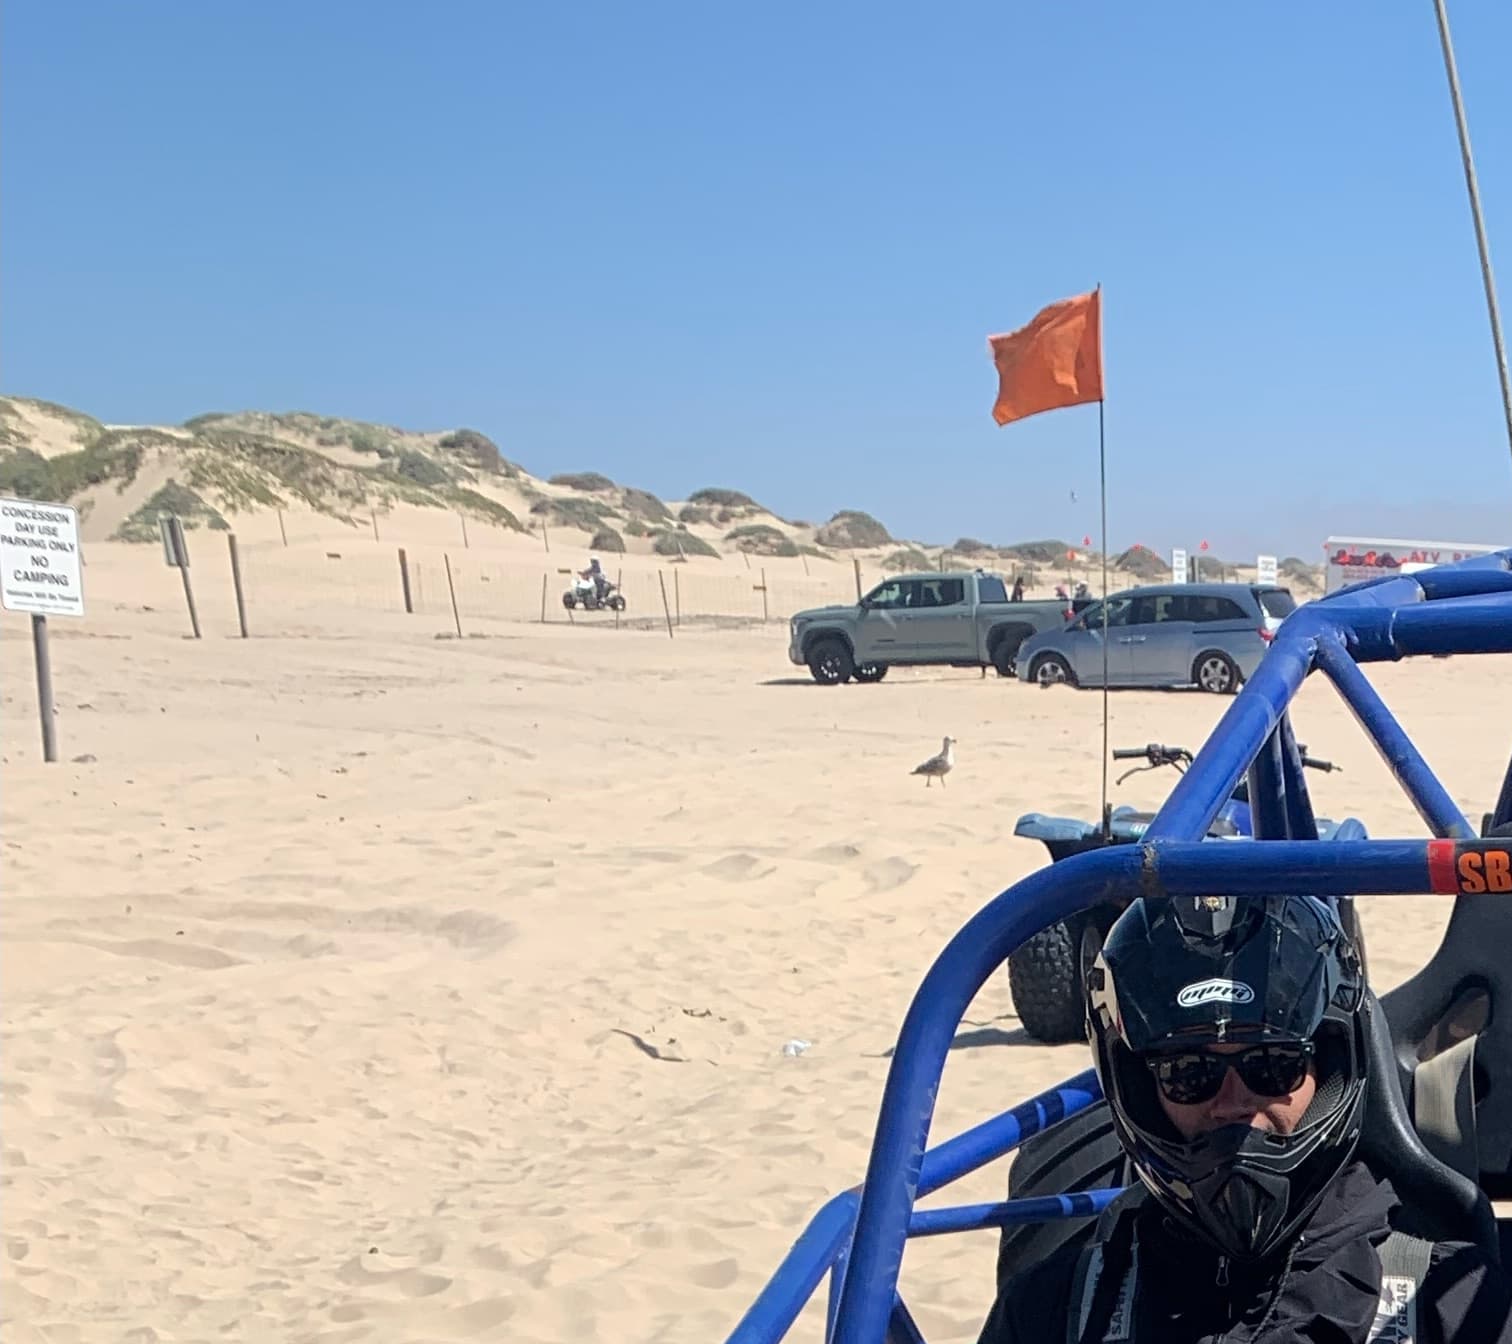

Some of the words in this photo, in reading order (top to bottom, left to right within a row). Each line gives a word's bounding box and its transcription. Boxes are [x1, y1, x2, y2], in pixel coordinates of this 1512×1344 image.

[1, 507, 70, 524] CONCESSION
[15, 521, 35, 534] DAY
[38, 525, 59, 538] USE
[0, 534, 47, 550] PARKING
[48, 541, 75, 553] ONLY
[30, 555, 49, 568] NO
[13, 569, 70, 587] CAMPING
[1396, 1283, 1409, 1327] GEAR
